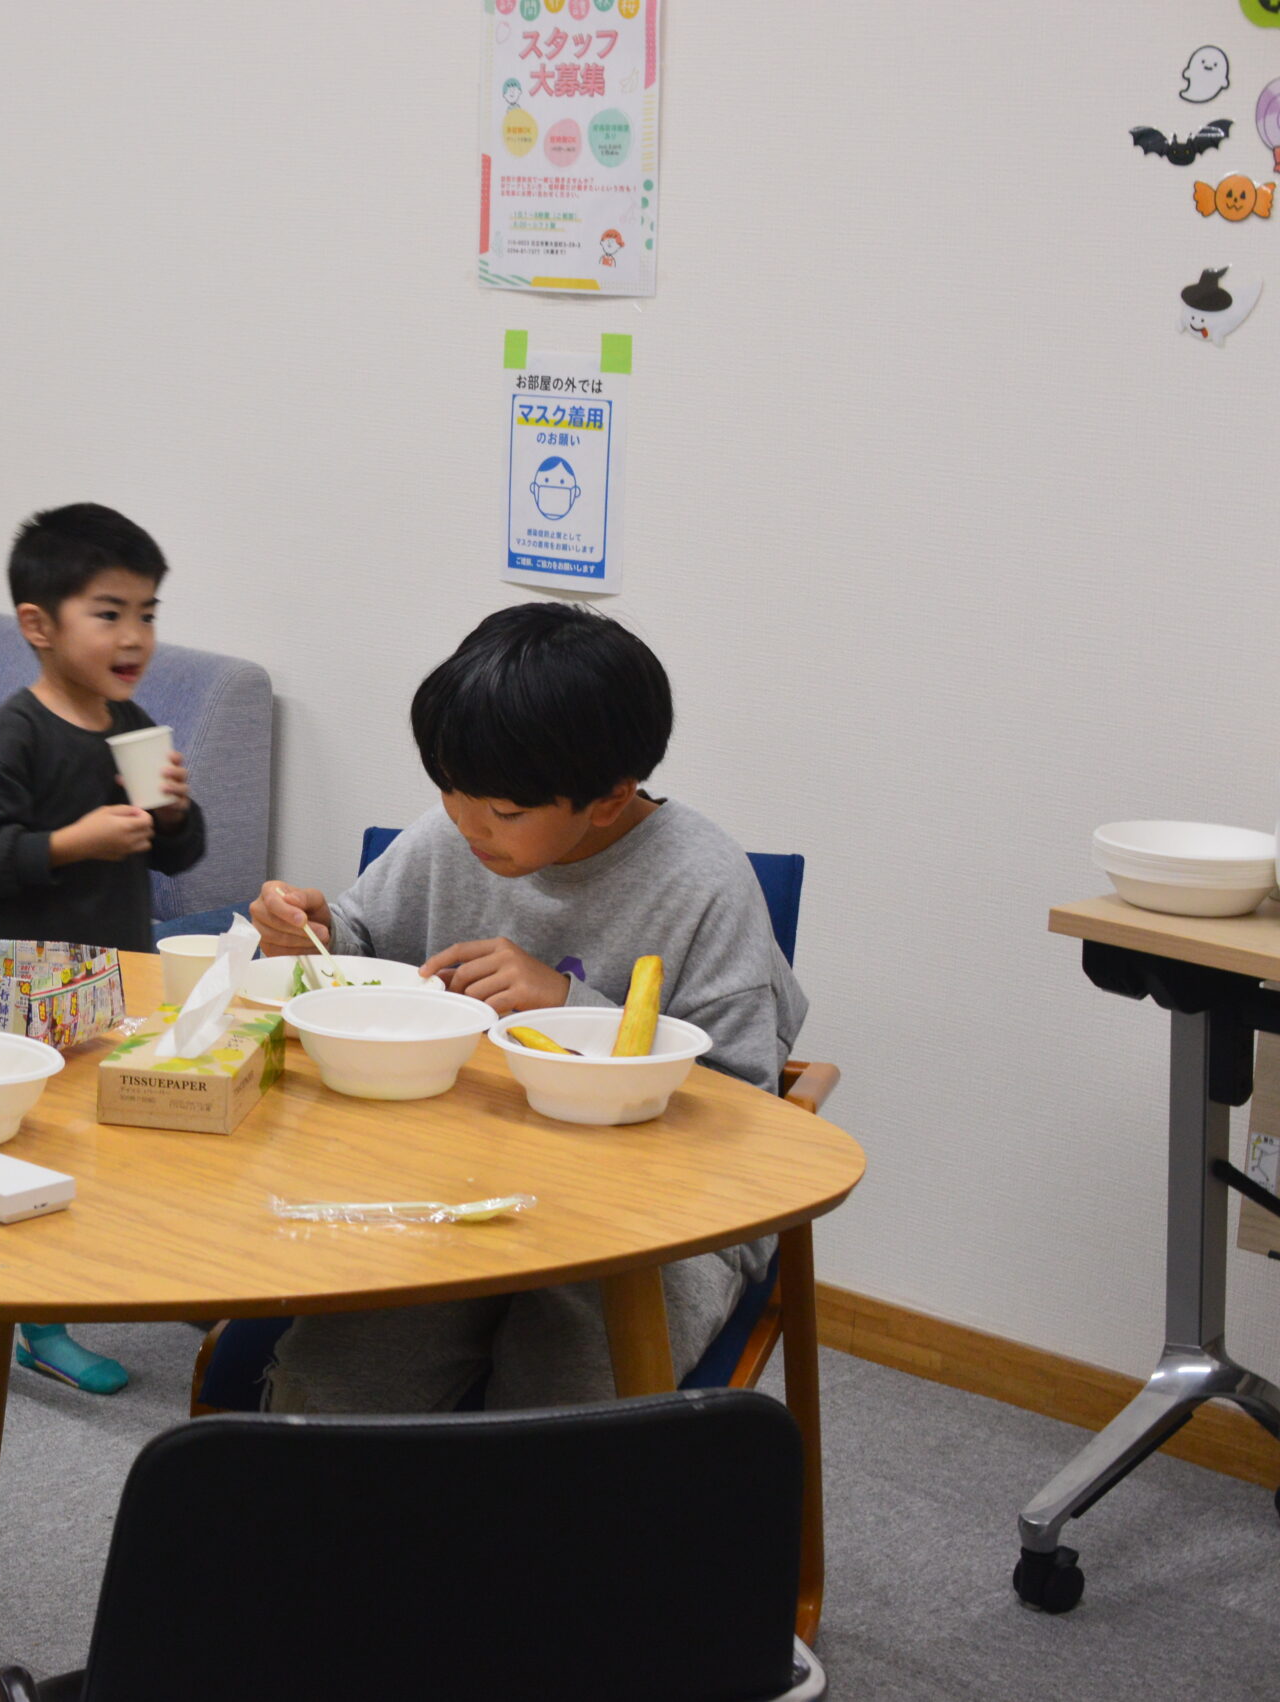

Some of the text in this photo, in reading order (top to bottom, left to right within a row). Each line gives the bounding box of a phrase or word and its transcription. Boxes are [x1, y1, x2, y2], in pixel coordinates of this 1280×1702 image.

[519, 27, 619, 60] スタッフ
[528, 63, 606, 98] 大募集
[516, 375, 603, 394] お部屋の外では
[519, 404, 604, 429] マスク着用
[536, 432, 580, 447] のお願い
[515, 538, 595, 554] マスクの着用をお願いします
[120, 1075, 207, 1092] TISSUEPAPER
